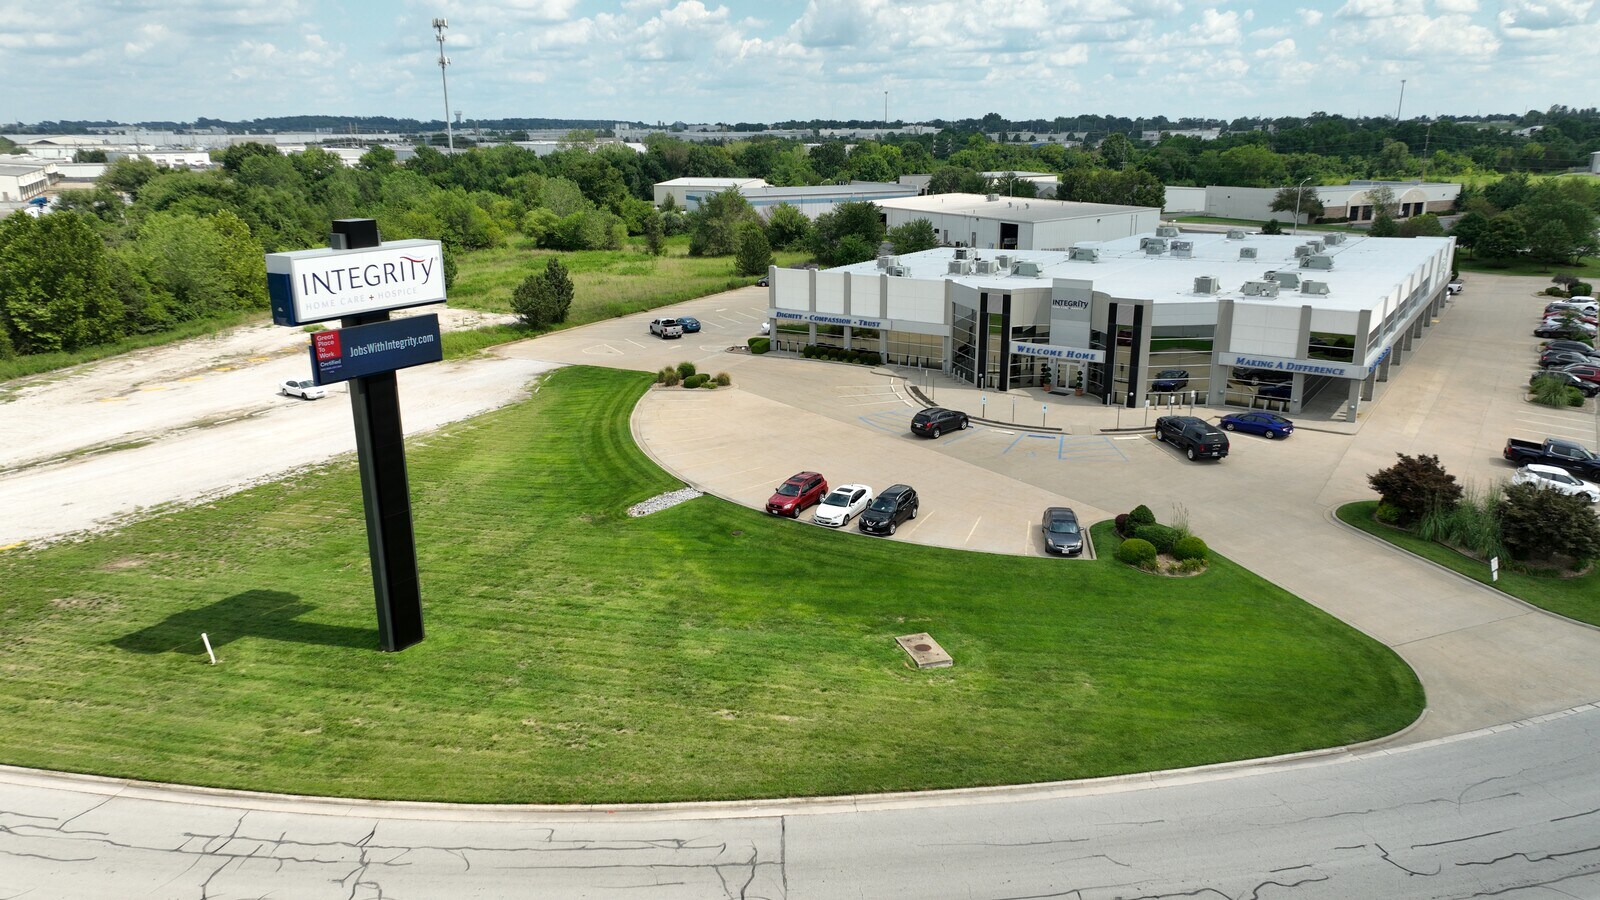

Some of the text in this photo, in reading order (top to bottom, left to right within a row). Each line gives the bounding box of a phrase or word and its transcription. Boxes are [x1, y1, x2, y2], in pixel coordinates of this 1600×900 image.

[305, 300, 336, 311] HOME
[340, 295, 366, 306] CARE
[378, 287, 417, 300] HOSPICE
[776, 311, 881, 328] DIGNITY COMPASSION TRUST
[350, 334, 434, 358] JobsWithIntegrity.com
[1017, 345, 1096, 361] WELCOME HOME
[1236, 357, 1346, 376] MAKING A DIFFERENCE
